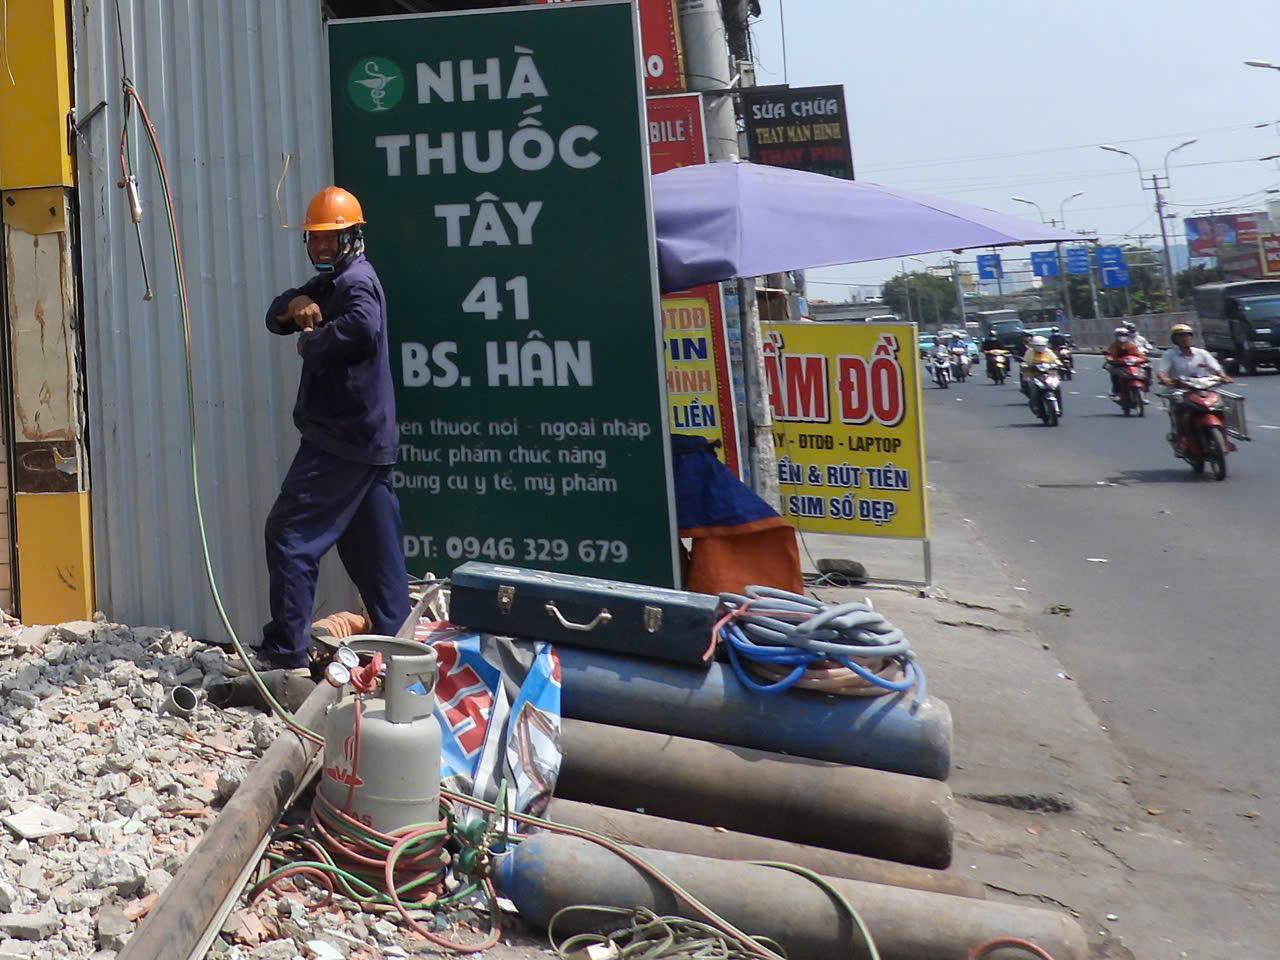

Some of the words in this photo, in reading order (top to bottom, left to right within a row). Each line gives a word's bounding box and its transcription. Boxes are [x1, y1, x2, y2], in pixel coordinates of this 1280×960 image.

[416, 45, 549, 104] NHÀ
[375, 104, 601, 177] THUỐC
[434, 191, 544, 247] TÂY
[461, 276, 530, 320] 41
[401, 341, 471, 387] BS.
[486, 329, 593, 387] HÂN
[839, 335, 901, 422] ĐỒ
[848, 436, 902, 453] LAPTOP
[808, 465, 821, 484] &
[827, 462, 861, 486] RÚT
[789, 495, 824, 516] SIM
[830, 491, 855, 519] SỐ
[859, 499, 895, 525] ĐẸP
[446, 536, 516, 560] 0946
[523, 538, 569, 562] 329
[578, 539, 628, 563] 679
